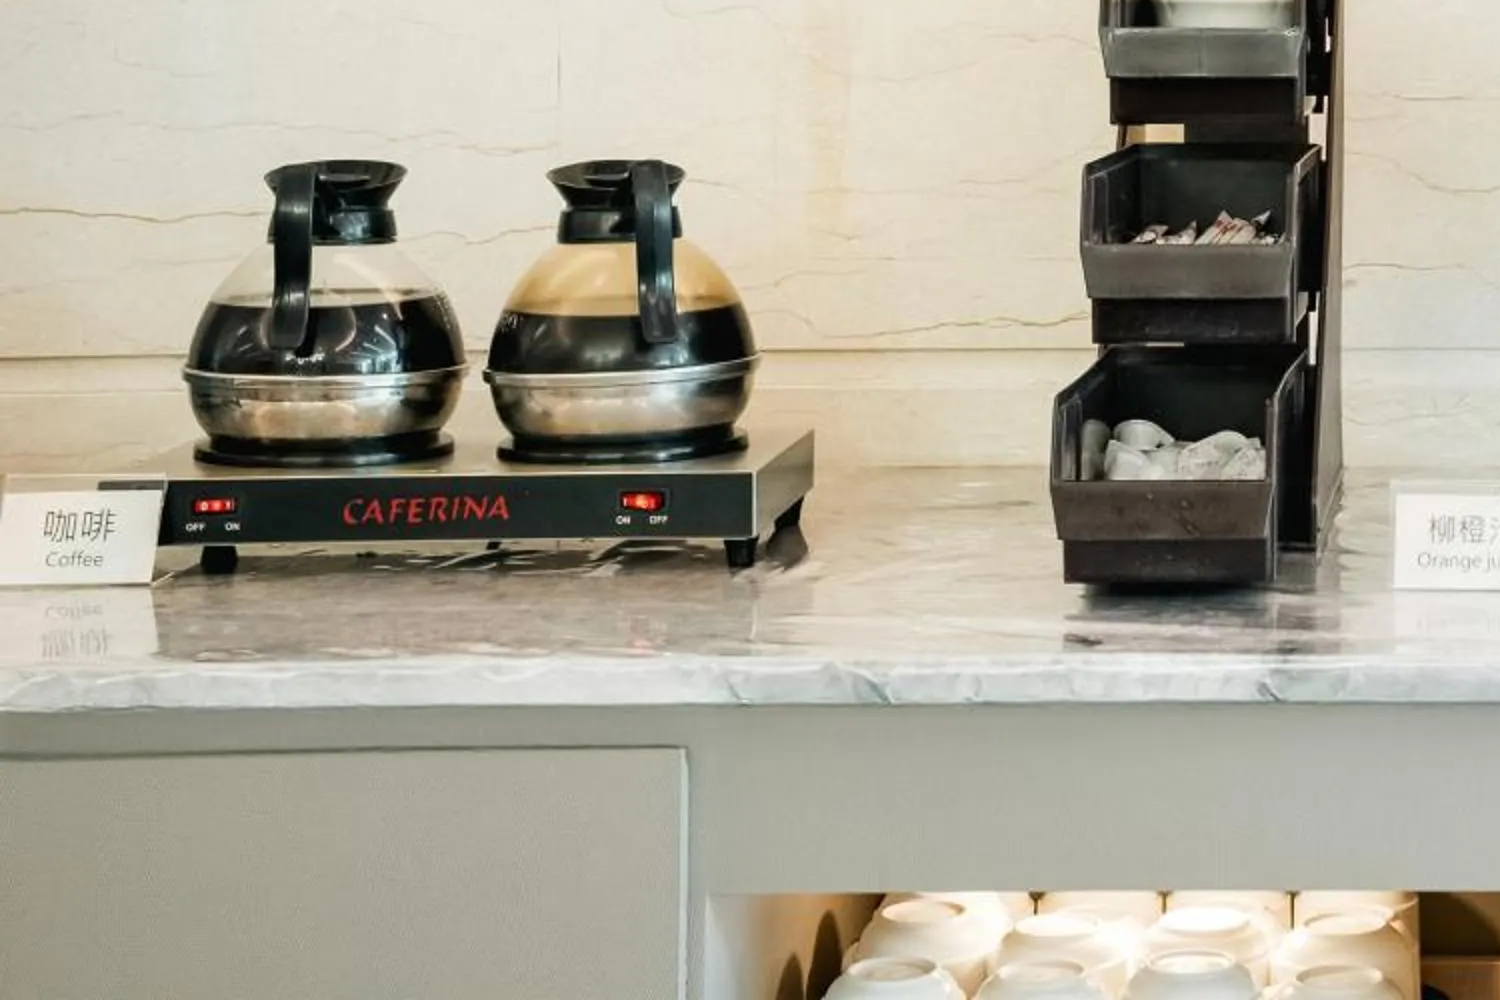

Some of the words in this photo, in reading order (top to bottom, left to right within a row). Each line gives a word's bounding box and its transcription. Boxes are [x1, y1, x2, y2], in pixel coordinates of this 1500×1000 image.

[342, 494, 511, 526] CAFERINA
[43, 507, 117, 543] 咖啡
[224, 521, 241, 532] ON
[615, 514, 631, 525] ON
[649, 514, 669, 525] OFF
[185, 522, 206, 533] OFF
[45, 550, 104, 568] Coffee
[1417, 551, 1483, 574] Orange
